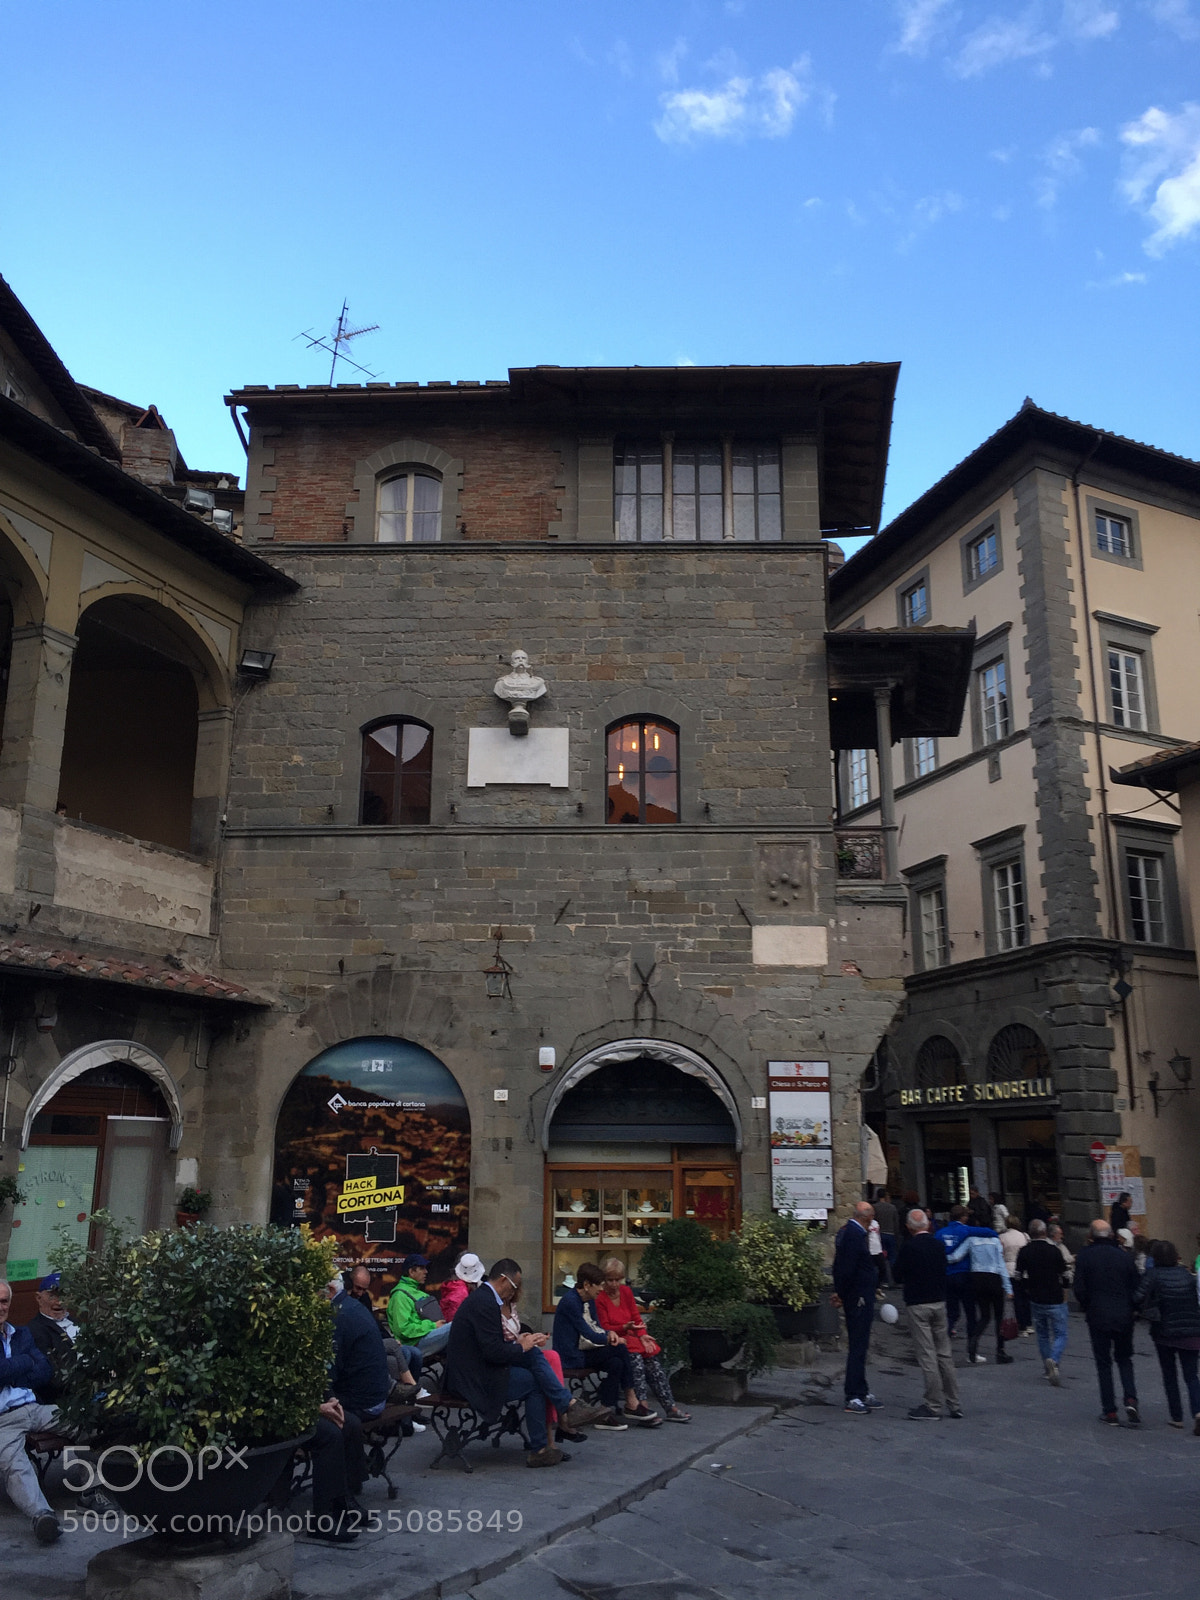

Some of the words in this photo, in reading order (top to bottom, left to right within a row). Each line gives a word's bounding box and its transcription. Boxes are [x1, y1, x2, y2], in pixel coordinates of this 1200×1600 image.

[900, 1089, 922, 1105] BAR
[973, 1077, 1052, 1101] SIGNORELLI
[347, 1099, 367, 1107] banca
[368, 1100, 395, 1108] popolare
[345, 1179, 374, 1191] HACK
[338, 1189, 402, 1210] CORTONA
[431, 1204, 450, 1213] MLH
